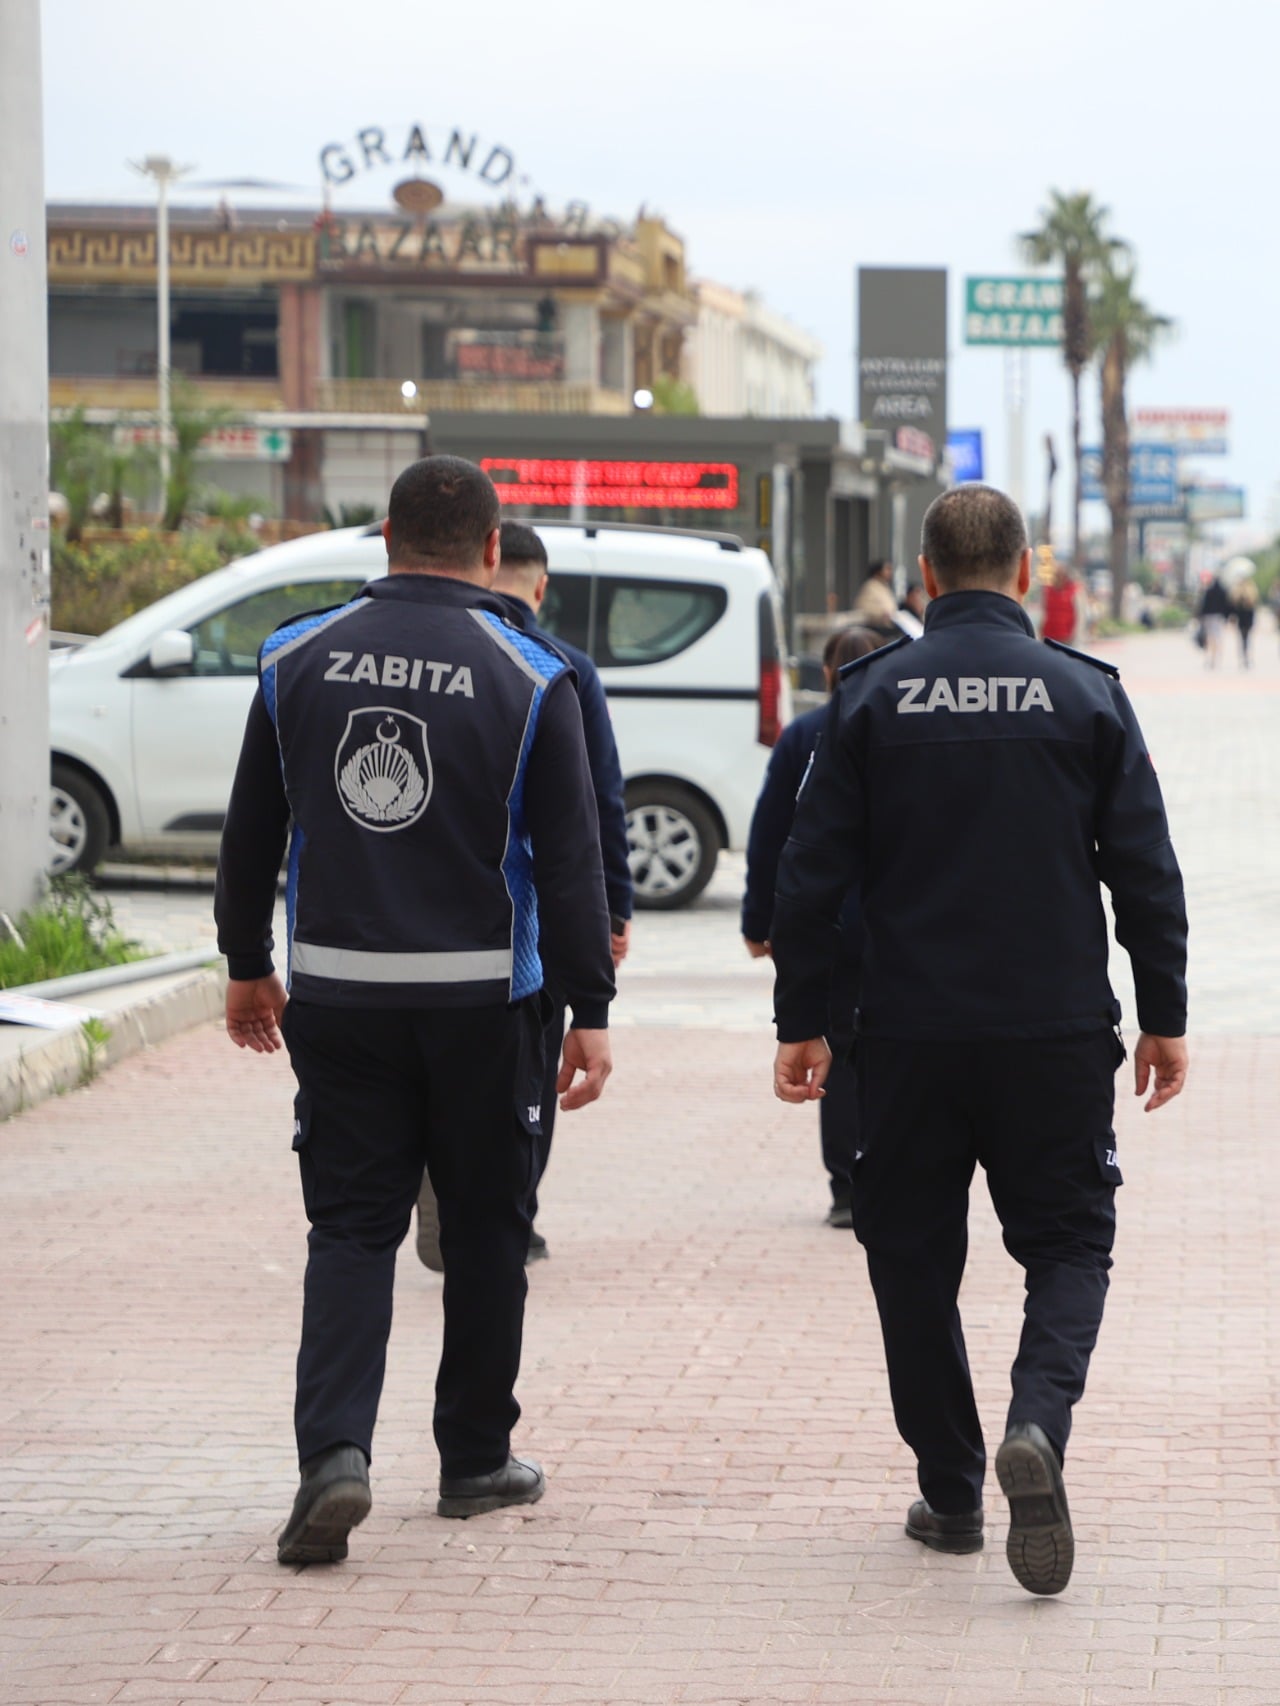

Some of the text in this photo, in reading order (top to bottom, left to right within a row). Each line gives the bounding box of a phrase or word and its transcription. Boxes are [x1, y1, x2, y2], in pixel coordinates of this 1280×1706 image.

[319, 123, 515, 185] GRAND
[974, 281, 1064, 309] GRAN
[967, 313, 1065, 340] BAZAA
[324, 651, 475, 699] ZABITA
[897, 677, 1054, 713] ZABITA
